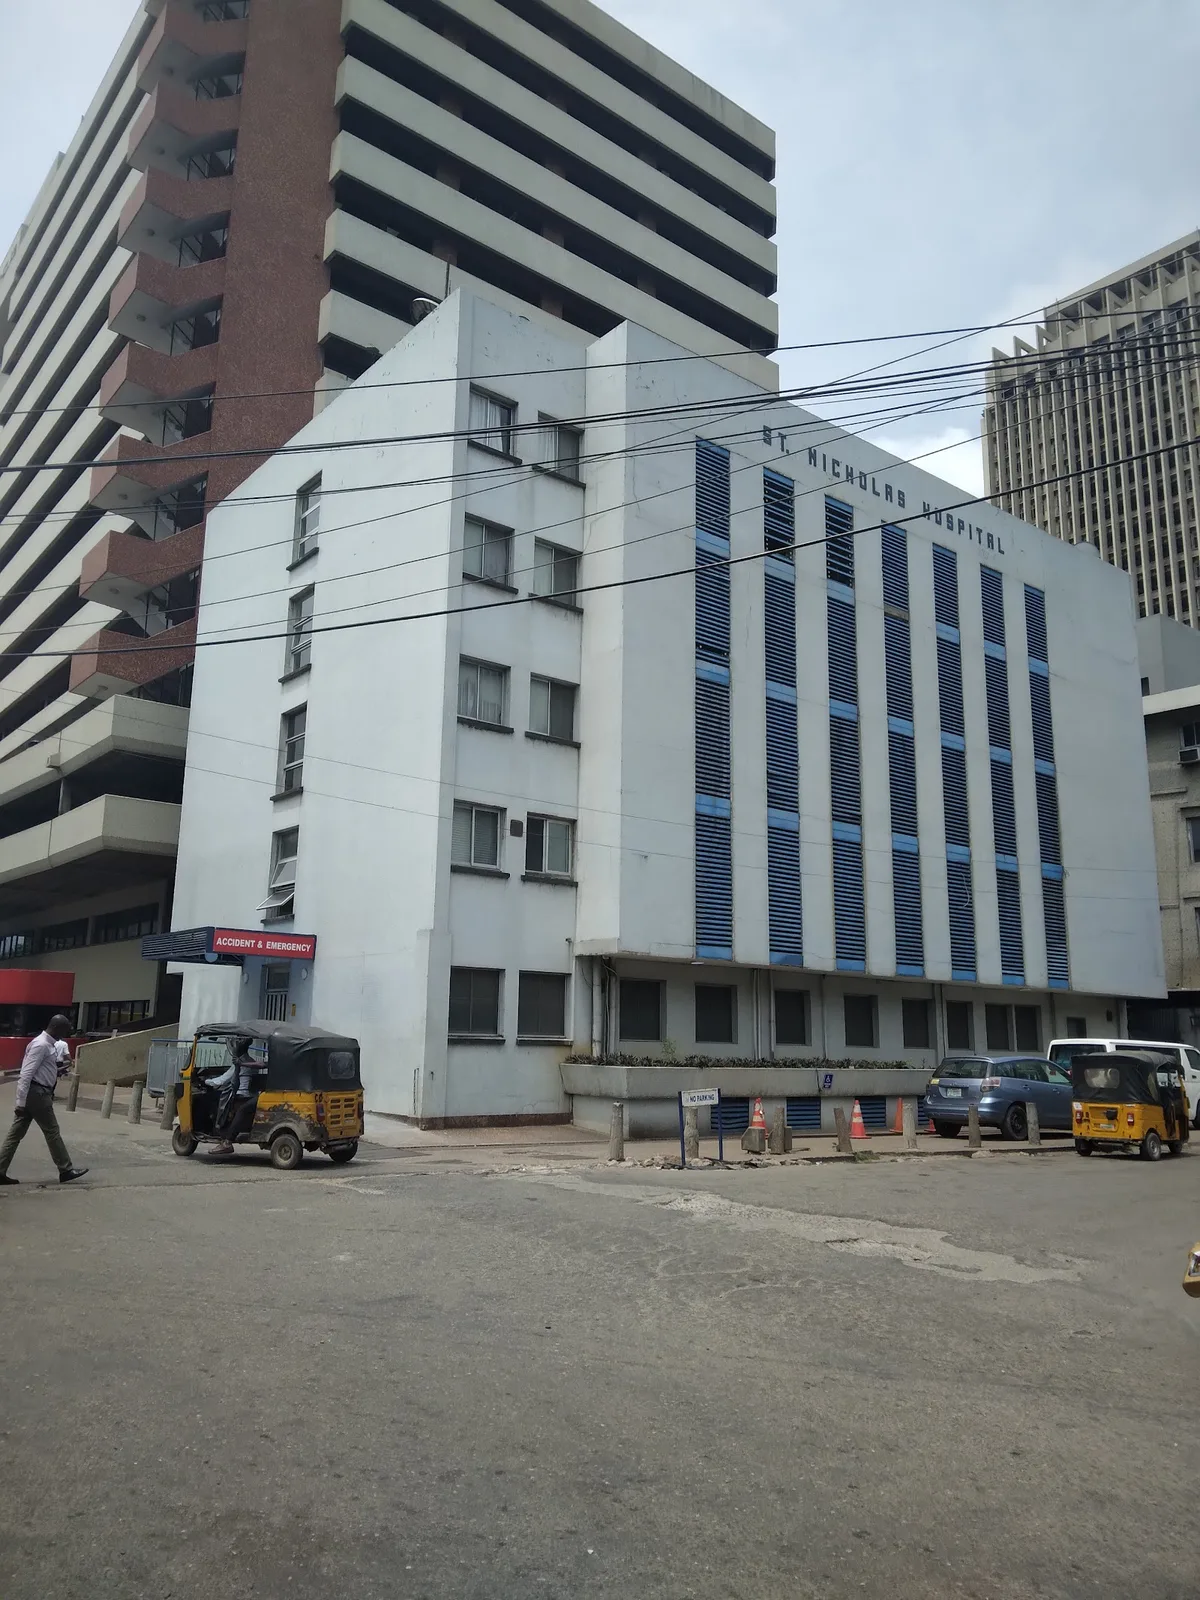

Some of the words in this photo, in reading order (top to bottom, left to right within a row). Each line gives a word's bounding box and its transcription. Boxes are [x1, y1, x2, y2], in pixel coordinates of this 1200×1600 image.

[763, 425, 790, 454] ST.
[809, 447, 905, 509] NICHOLAS
[923, 501, 1005, 555] HOSPITAL
[216, 937, 255, 948] ACCIDENT
[257, 940, 263, 949] &
[266, 941, 311, 952] EMERGENCY
[696, 1094, 715, 1102] PARKING
